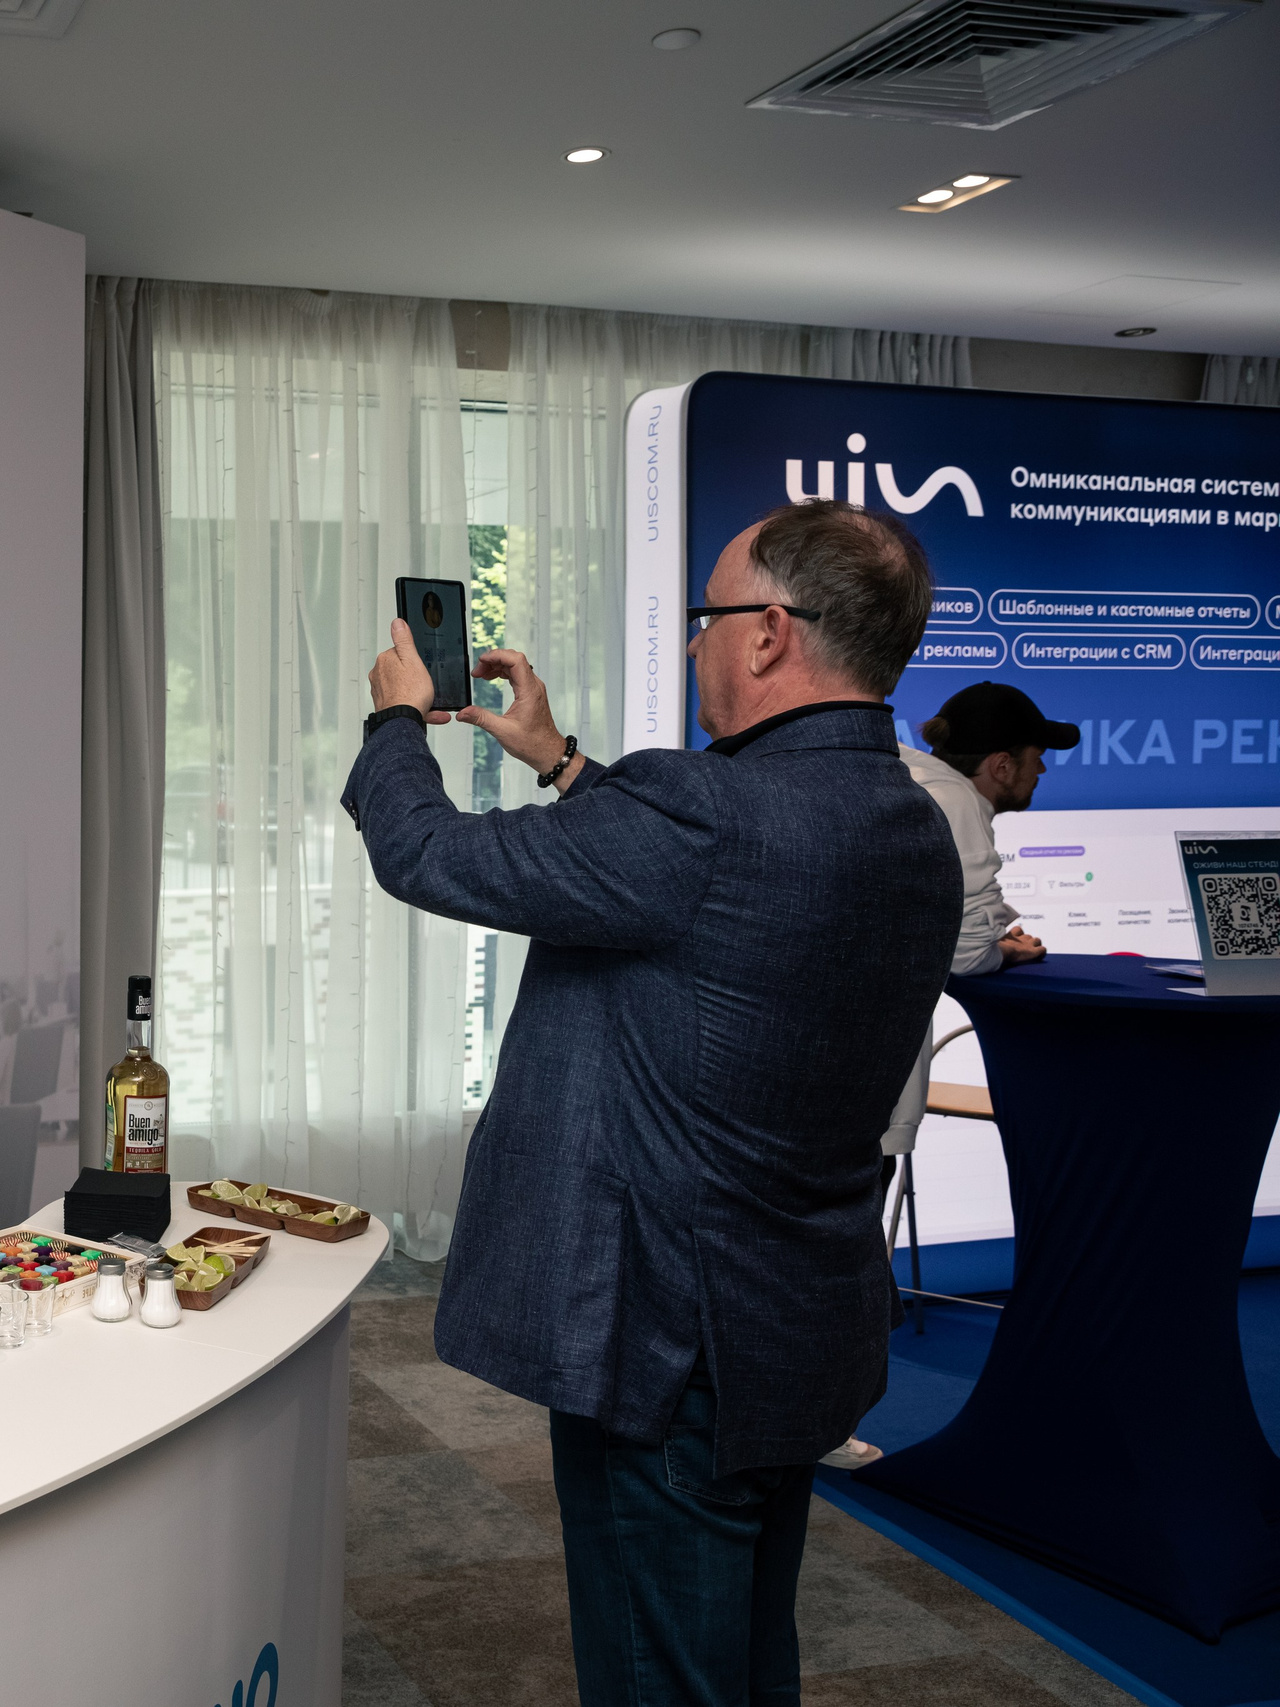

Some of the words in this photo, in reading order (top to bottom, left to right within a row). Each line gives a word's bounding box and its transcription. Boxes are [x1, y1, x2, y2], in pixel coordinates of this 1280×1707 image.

[647, 405, 662, 542] UISCOM.RU
[1010, 465, 1196, 495] Омниканальная
[1201, 477, 1280, 498] систем
[1010, 502, 1211, 527] коммуникациями
[1216, 510, 1229, 526] в
[1234, 510, 1280, 533] мар
[998, 598, 1094, 617] Шаблонные
[1097, 602, 1108, 616] и
[1110, 602, 1195, 618] кастомные
[1197, 606, 1251, 619] отчеты
[646, 594, 660, 733] UISCOM.RU
[923, 644, 997, 661] рекламы
[1022, 642, 1119, 664] Интеграции
[1121, 646, 1131, 659] с
[1133, 643, 1172, 660] CRM
[1192, 718, 1280, 765] РЕ
[1192, 861, 1225, 870] ОЖИВИ
[1226, 860, 1246, 869] НАШ
[1247, 860, 1279, 868] СТЕНД!
[128, 1113, 151, 1129] Buen
[128, 1128, 159, 1146] amigo
